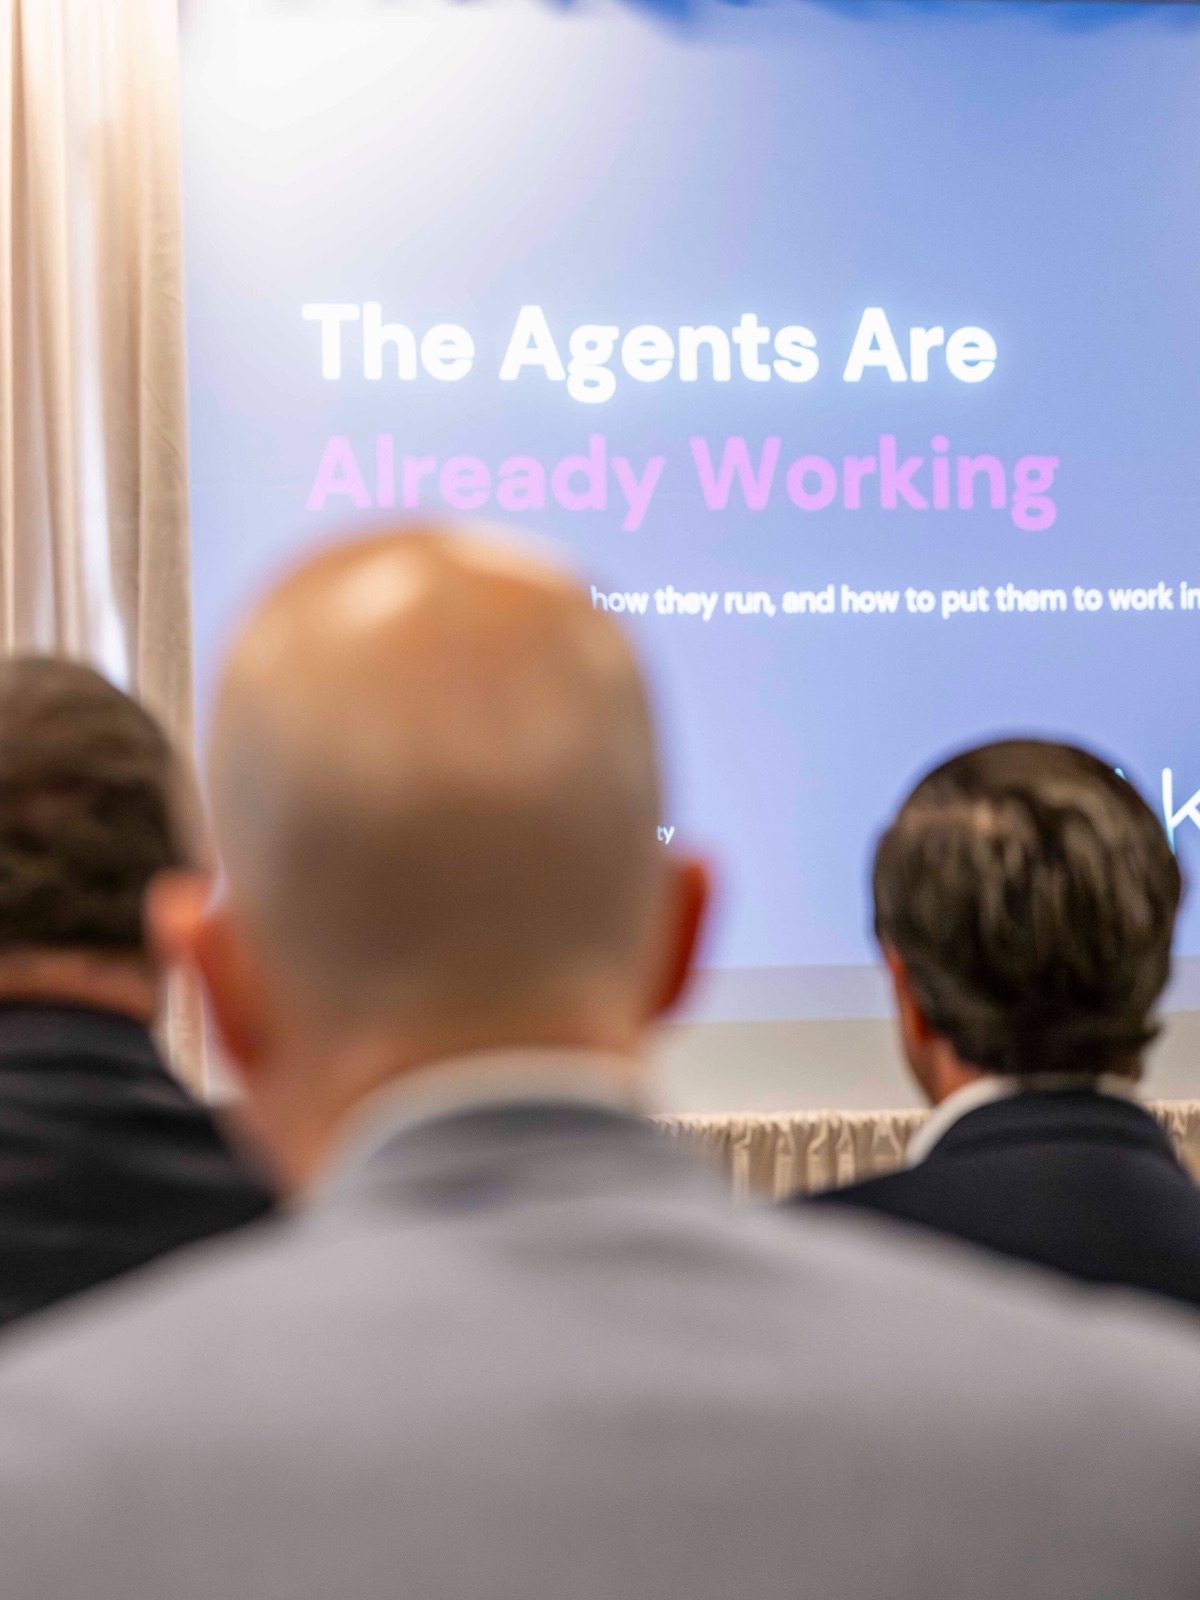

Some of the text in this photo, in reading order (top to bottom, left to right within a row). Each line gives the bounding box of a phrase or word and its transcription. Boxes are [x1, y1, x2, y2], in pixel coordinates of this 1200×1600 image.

[302, 301, 998, 403] The Agents Are
[305, 433, 1060, 531] Already Working
[591, 585, 649, 614] how
[653, 585, 718, 622] they
[723, 590, 776, 617] run,
[781, 584, 835, 614] and
[841, 584, 900, 613] how
[904, 587, 936, 613] to
[941, 586, 990, 619] put
[994, 582, 1067, 612] them
[1072, 585, 1103, 611] to
[1108, 581, 1174, 611] work
